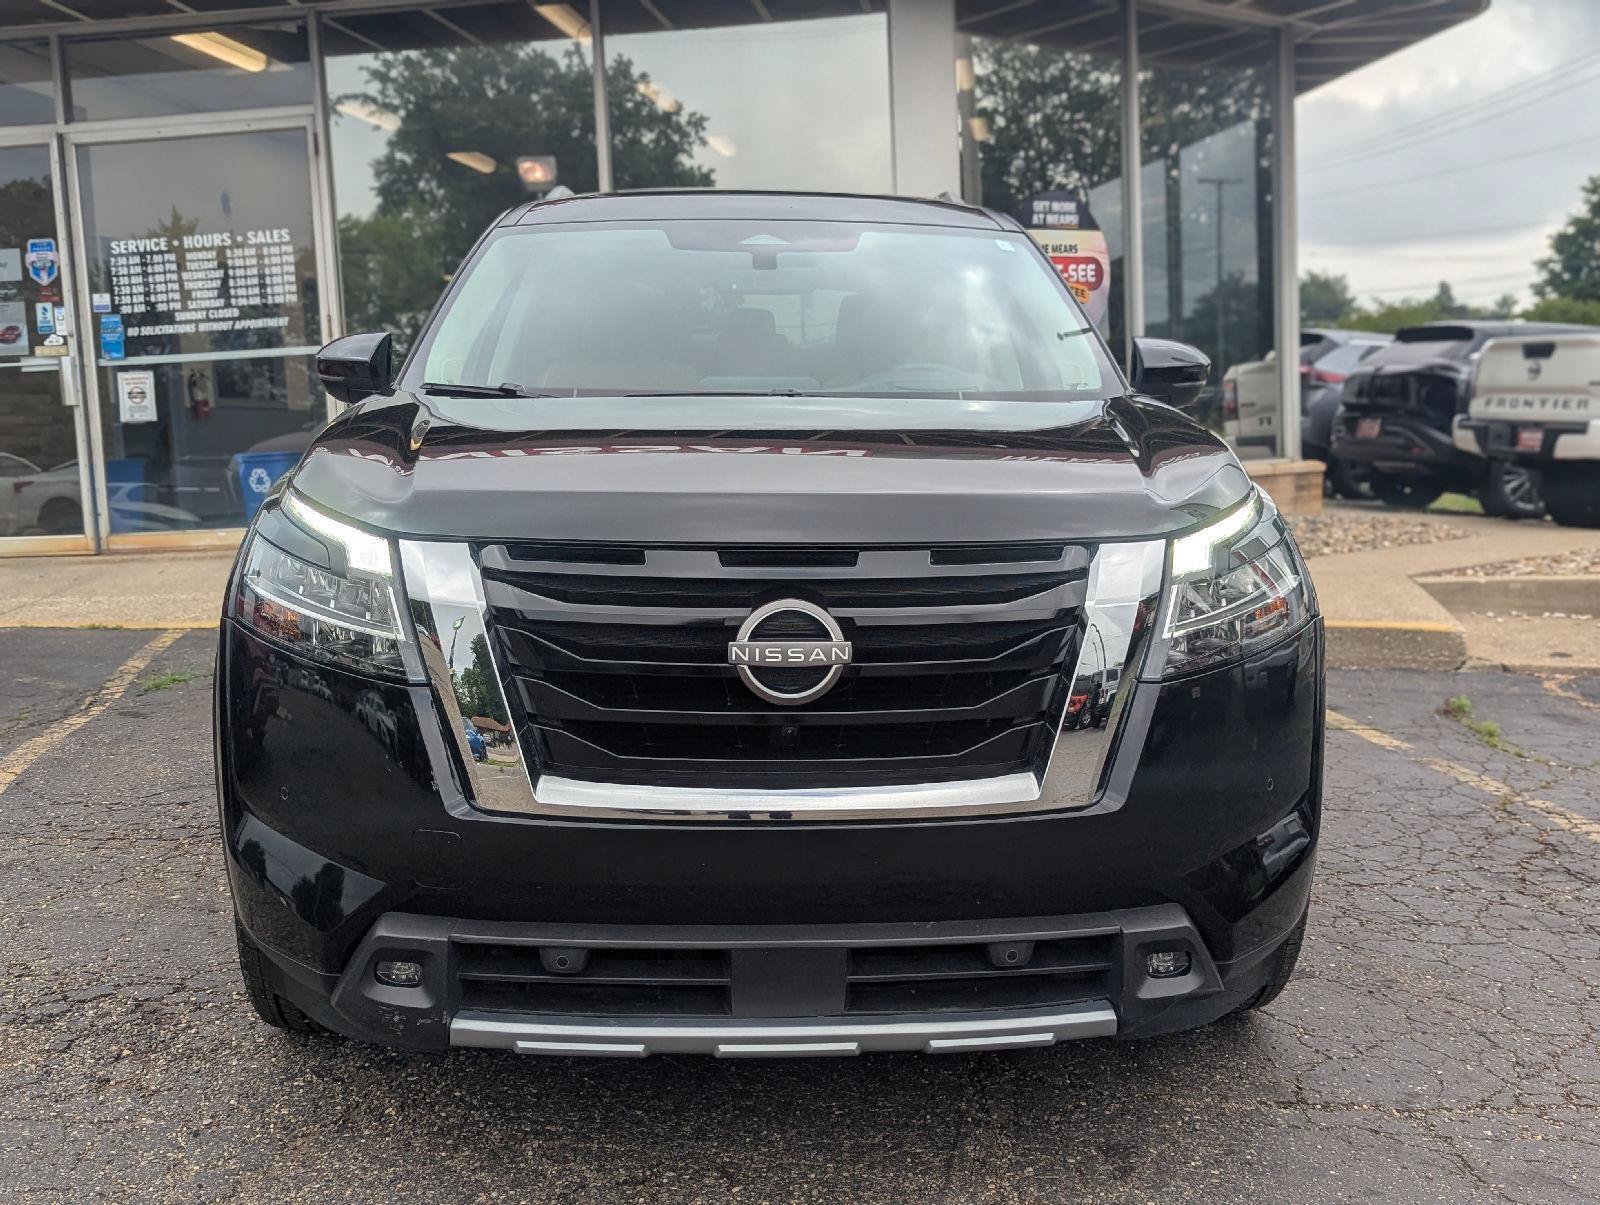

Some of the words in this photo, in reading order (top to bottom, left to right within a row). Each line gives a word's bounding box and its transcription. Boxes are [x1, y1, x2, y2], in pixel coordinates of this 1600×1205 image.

[110, 237, 168, 254] SERVICE
[183, 232, 232, 248] HOURS
[247, 228, 291, 244] SALES
[1052, 244, 1078, 254] MEARS
[129, 255, 141, 264] AM
[130, 266, 142, 274] AM
[131, 275, 143, 284] AM
[132, 284, 144, 293] AM
[132, 294, 144, 303] AM
[134, 304, 146, 312] AM
[174, 310, 206, 321] SUNDAY
[208, 308, 240, 318] CLOSED
[128, 326, 139, 337] NO
[198, 320, 233, 332] WITHOUT
[233, 316, 289, 330] APPOINTMENT
[1484, 398, 1589, 410] FRONTIER
[731, 646, 850, 662] NISSAN
